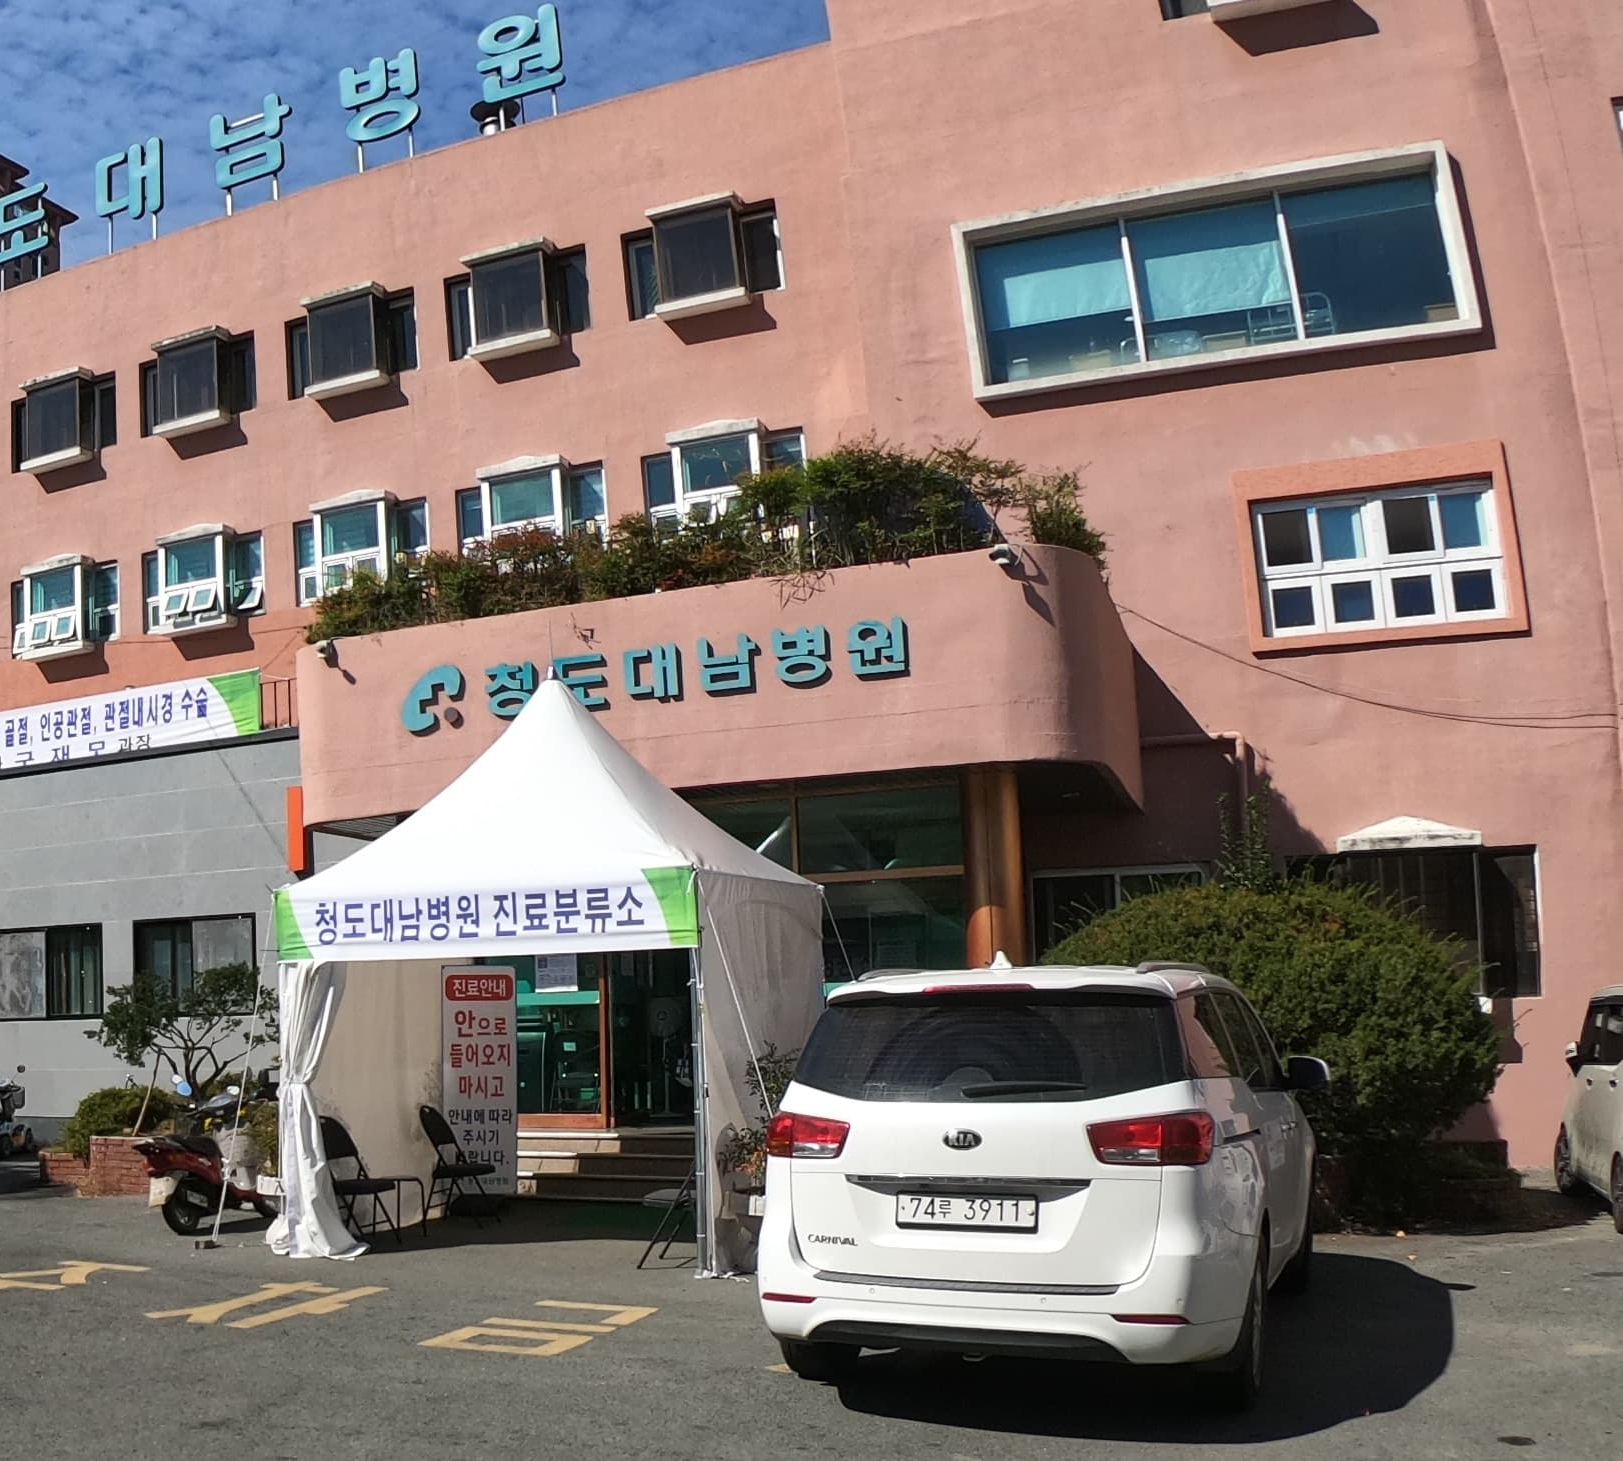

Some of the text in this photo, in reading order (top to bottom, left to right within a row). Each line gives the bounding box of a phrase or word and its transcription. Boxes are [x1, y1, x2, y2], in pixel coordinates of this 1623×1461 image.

[483, 615, 910, 718] 청도대남병원
[40, 705, 97, 742] 인공관절,
[104, 692, 173, 733] 관절내시경
[180, 687, 209, 721] 수술
[315, 886, 645, 945] 청도대남병원 진료분류소
[453, 979, 506, 997] 진료안내
[454, 1010, 508, 1037] 안으로
[450, 1043, 511, 1068] 들어오지
[458, 1075, 505, 1099] 마시고
[448, 1108, 512, 1125] 안내에 따라
[463, 1129, 499, 1145] 주시기
[947, 1132, 977, 1146] KIA
[909, 1198, 1020, 1222] 74루 3911
[808, 1233, 859, 1247] CARNIVAL
